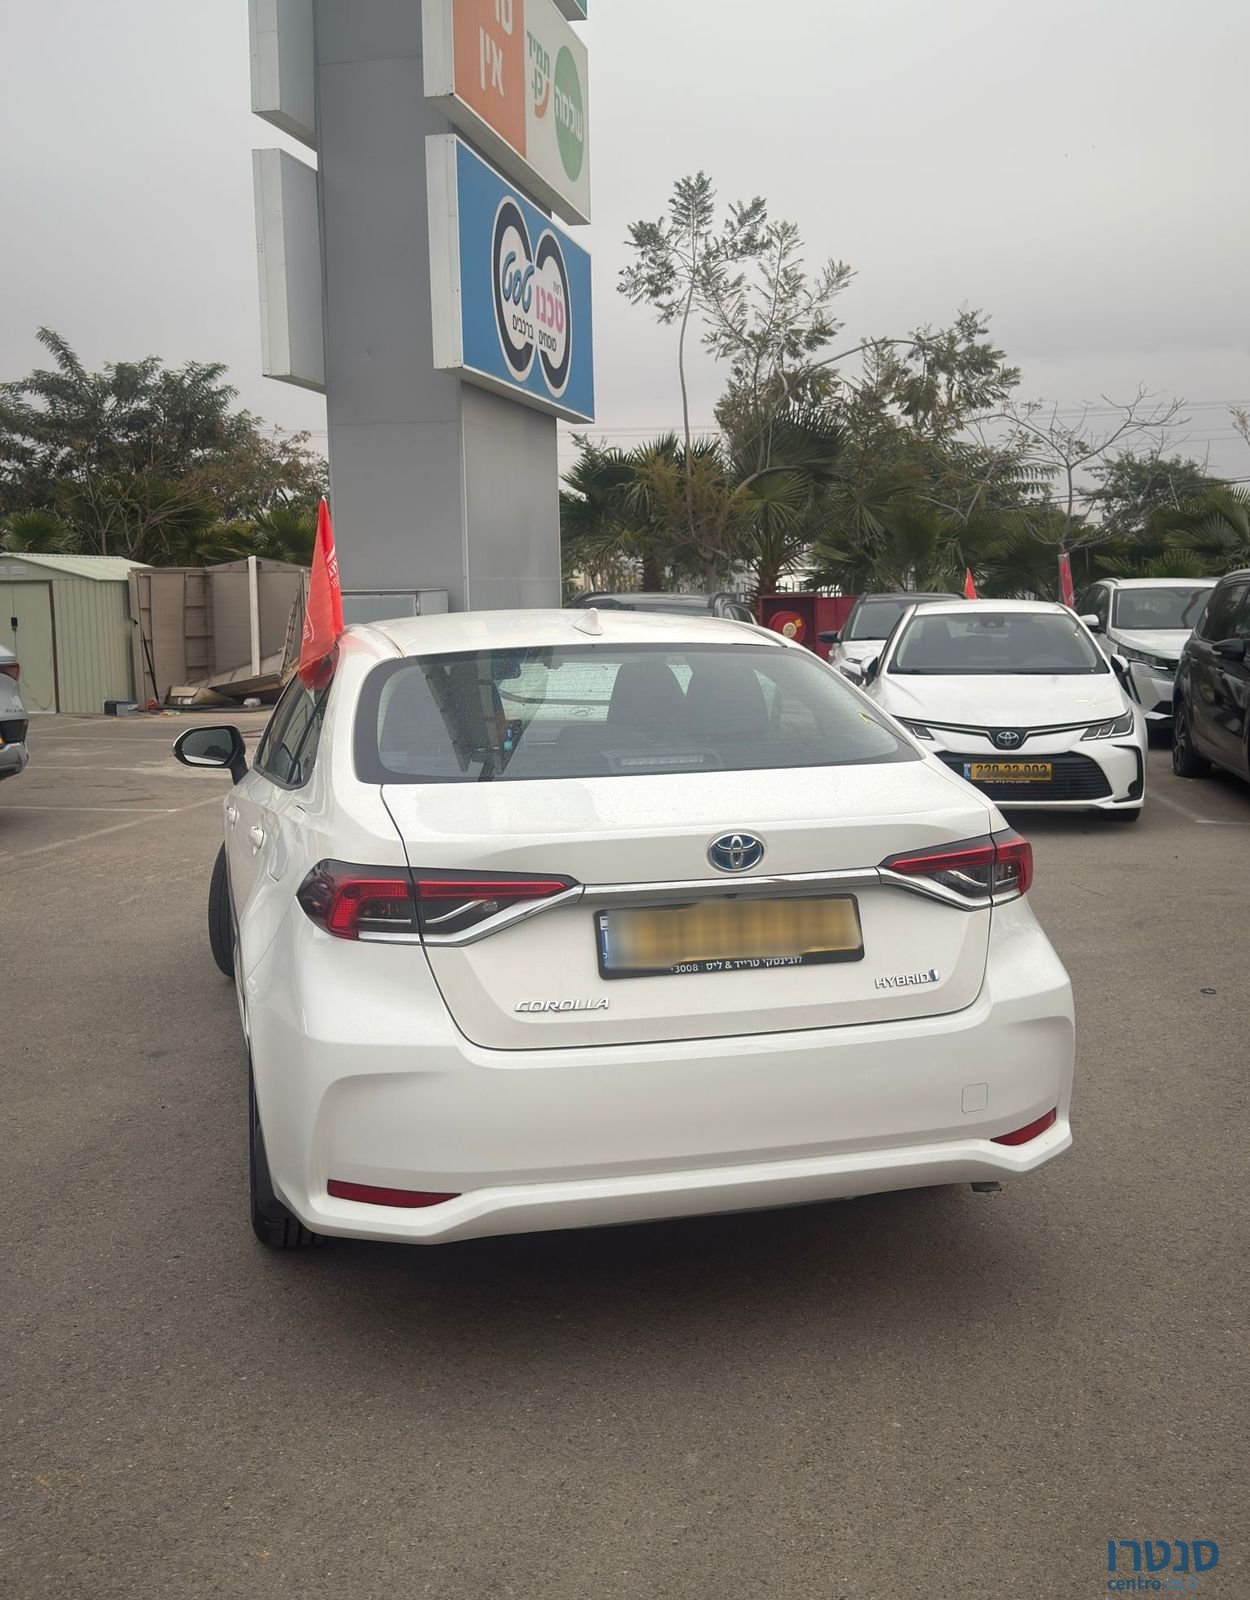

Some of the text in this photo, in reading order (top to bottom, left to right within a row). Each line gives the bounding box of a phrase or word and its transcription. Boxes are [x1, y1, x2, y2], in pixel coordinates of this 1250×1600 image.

[526, 29, 550, 80] תמיד
[554, 85, 584, 143] שלמה
[512, 314, 534, 340] ברכבים
[705, 961, 723, 973] ליס
[724, 961, 733, 970] &
[734, 958, 761, 969] טרייד
[762, 955, 803, 968] לובינסקי
[875, 972, 929, 989] HYBRID
[514, 997, 609, 1013] COROLLA
